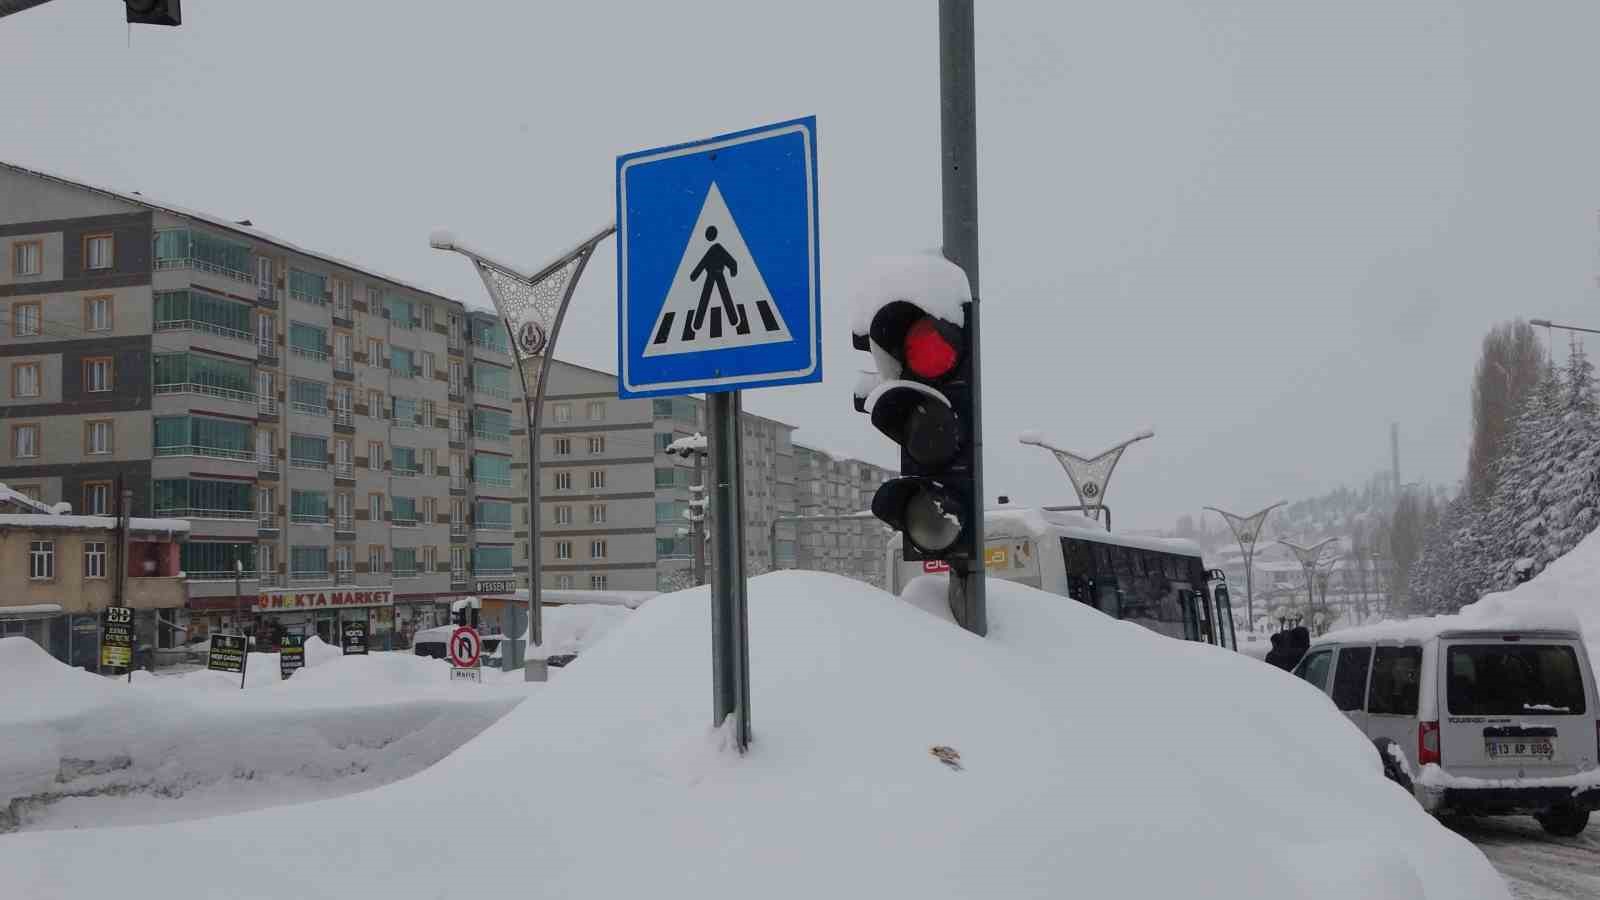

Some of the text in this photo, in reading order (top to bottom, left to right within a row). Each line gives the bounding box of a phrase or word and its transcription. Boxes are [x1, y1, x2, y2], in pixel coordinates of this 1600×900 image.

[331, 591, 391, 605] MARKET
[108, 607, 131, 623] ED
[1499, 744, 1509, 755] 13
